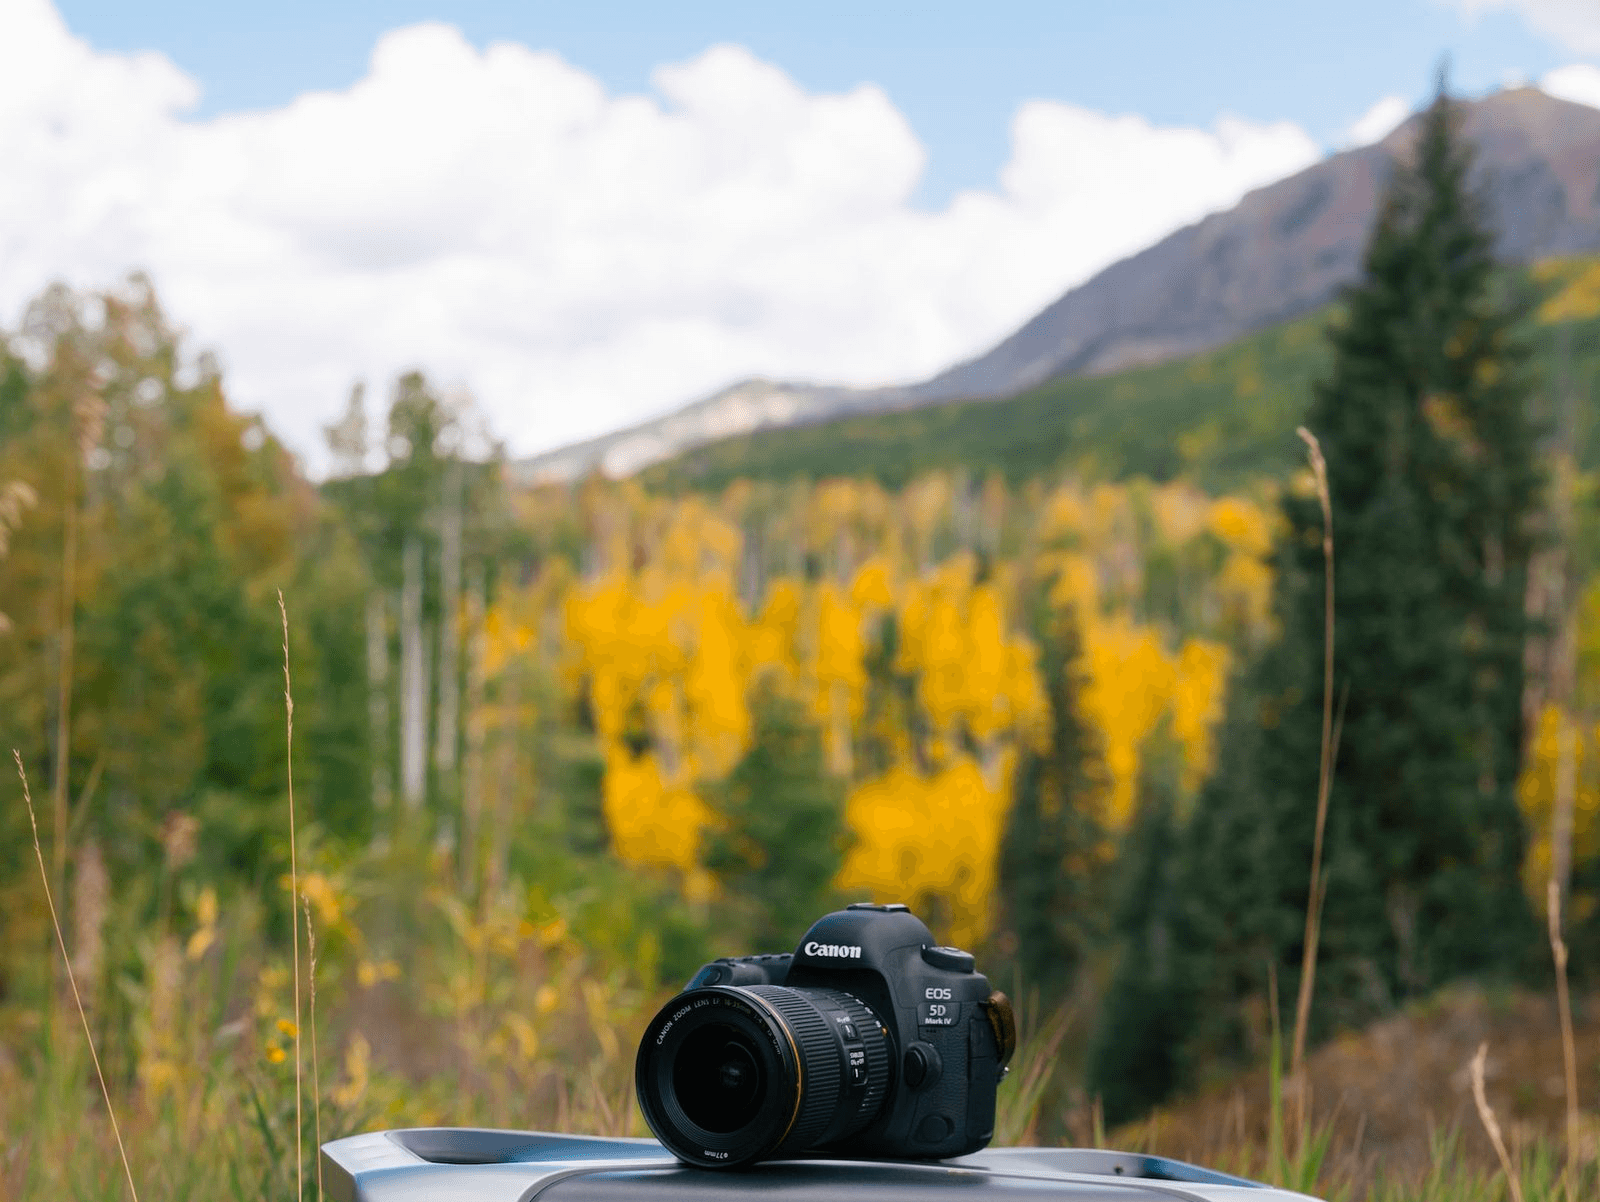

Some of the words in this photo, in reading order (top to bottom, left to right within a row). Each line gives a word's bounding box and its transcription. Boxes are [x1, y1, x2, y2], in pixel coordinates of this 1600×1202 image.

[804, 941, 861, 959] Canon
[925, 987, 951, 1000] EOS
[929, 1004, 946, 1016] 5D
[657, 1021, 673, 1045] CANON
[674, 1005, 692, 1021] ZOOM
[694, 999, 710, 1009] LENS
[925, 1017, 942, 1025] Mark
